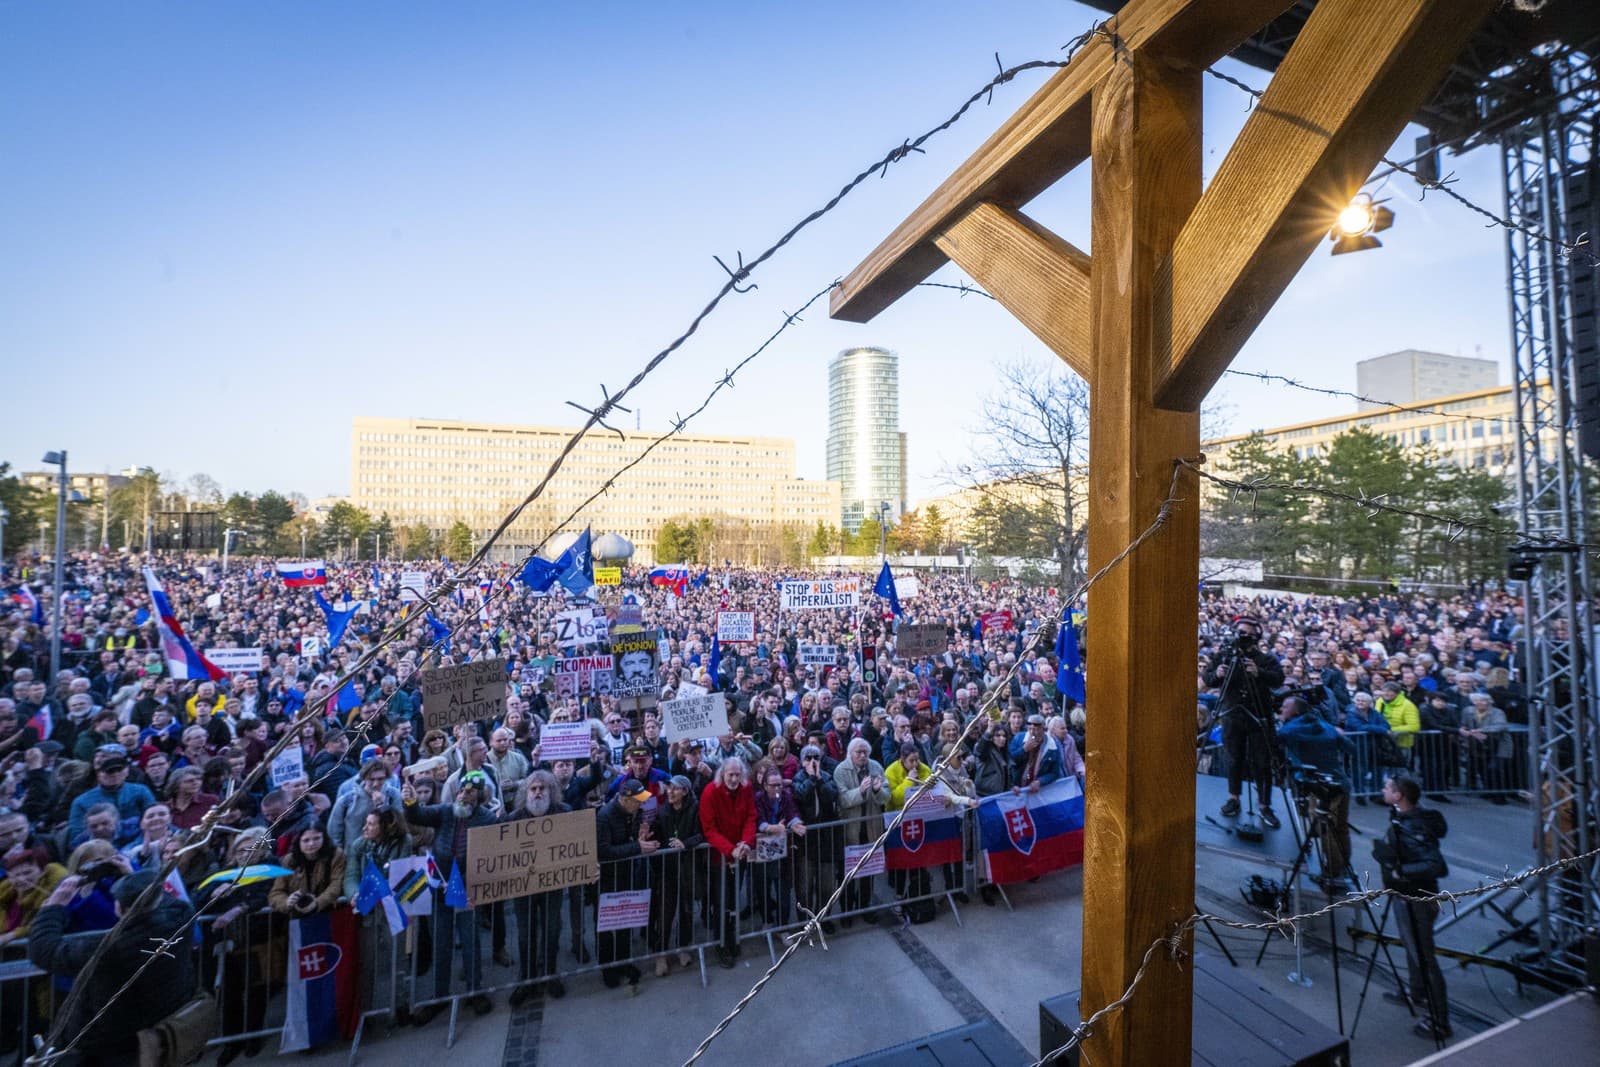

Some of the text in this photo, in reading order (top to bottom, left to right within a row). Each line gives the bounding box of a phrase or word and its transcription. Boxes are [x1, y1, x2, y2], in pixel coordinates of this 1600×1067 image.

[785, 582, 857, 595] STOP RUSSIAN
[788, 593, 852, 607] IMPERIALISM
[618, 631, 647, 643] PROTI
[424, 660, 500, 683] SLOVENSKO
[448, 687, 485, 708] ALE
[499, 818, 554, 841] FICO
[476, 840, 590, 874] PUTINOV TROLL
[471, 864, 591, 900] TRUMPOV REKTOFIL
